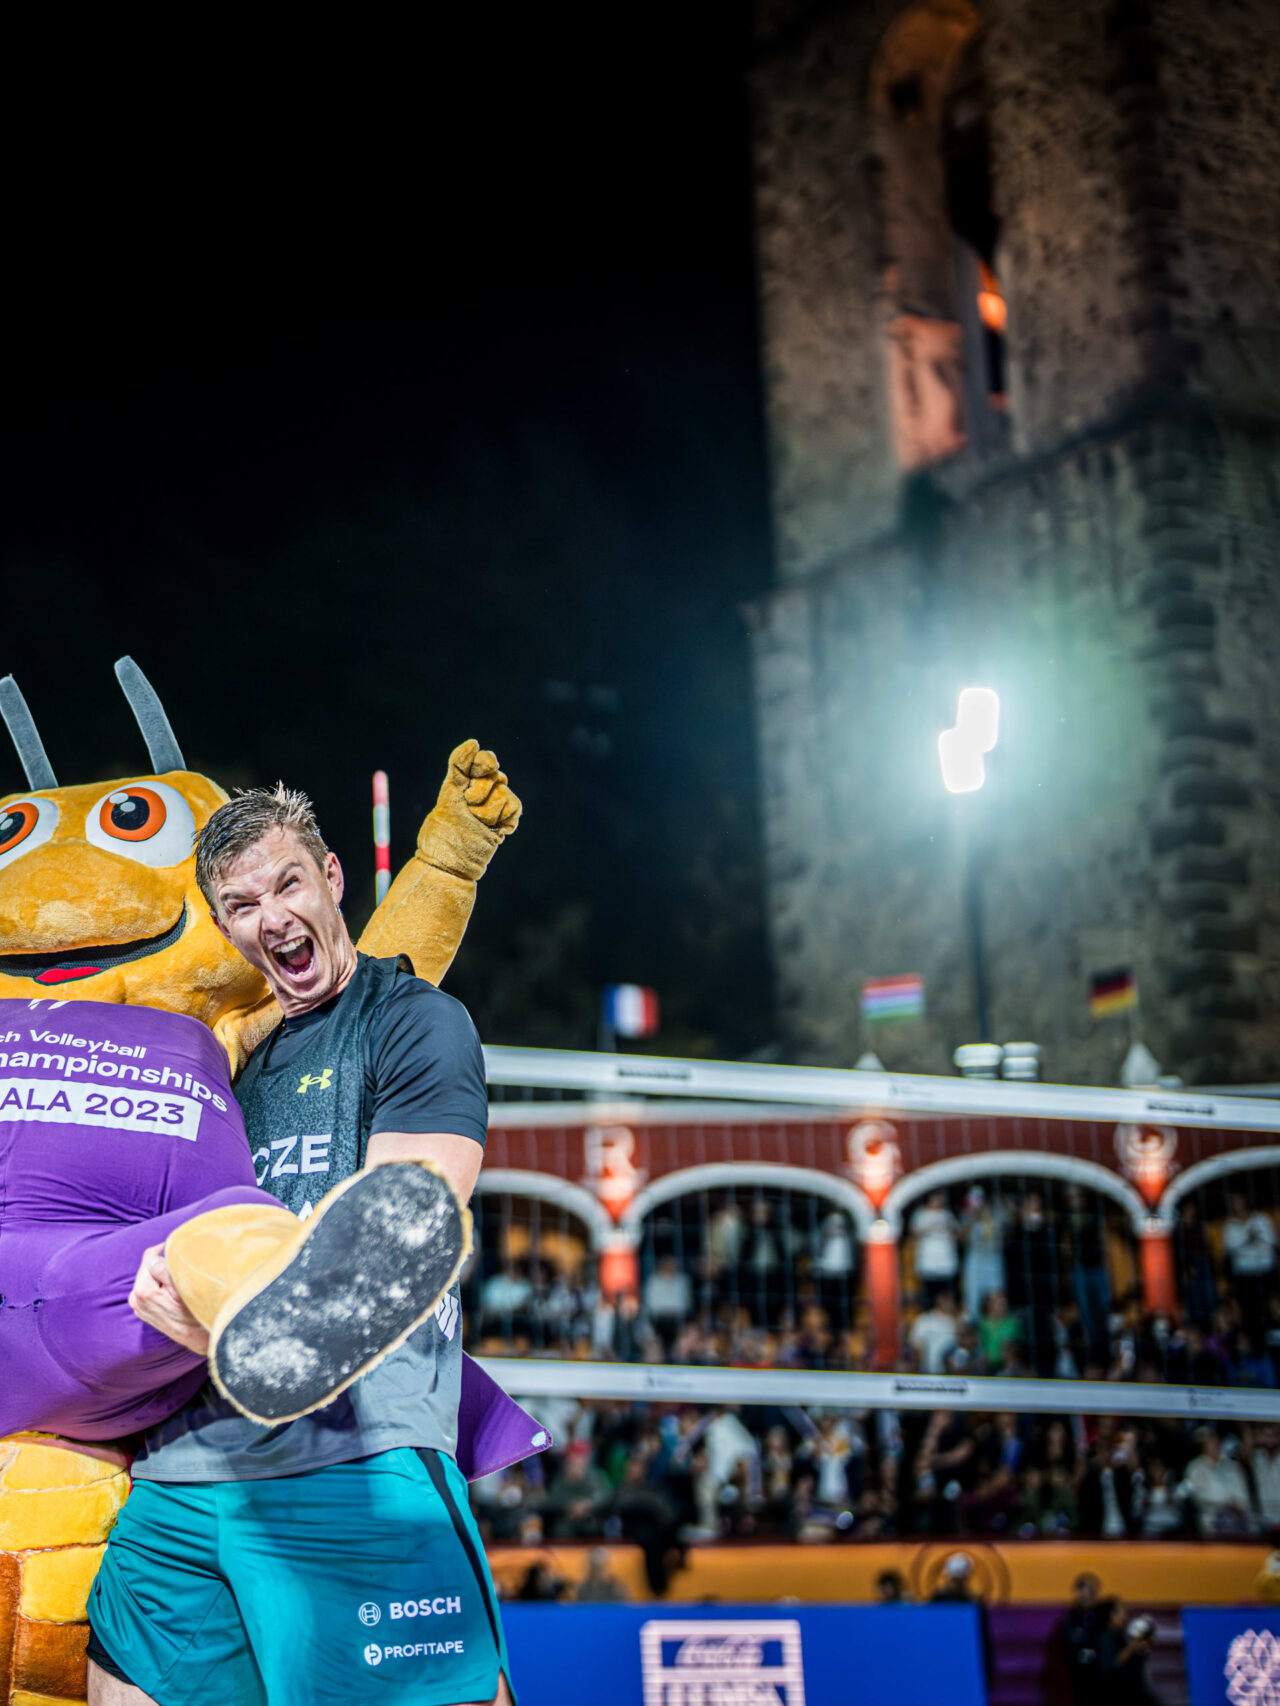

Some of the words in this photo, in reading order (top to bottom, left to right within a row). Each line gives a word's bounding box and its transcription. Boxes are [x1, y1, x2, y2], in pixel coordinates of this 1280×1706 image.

[29, 1029, 147, 1059] Volleyball
[84, 1093, 186, 1124] 2023
[389, 1596, 462, 1619] BOSCH
[384, 1640, 464, 1659] PROFITAPE
